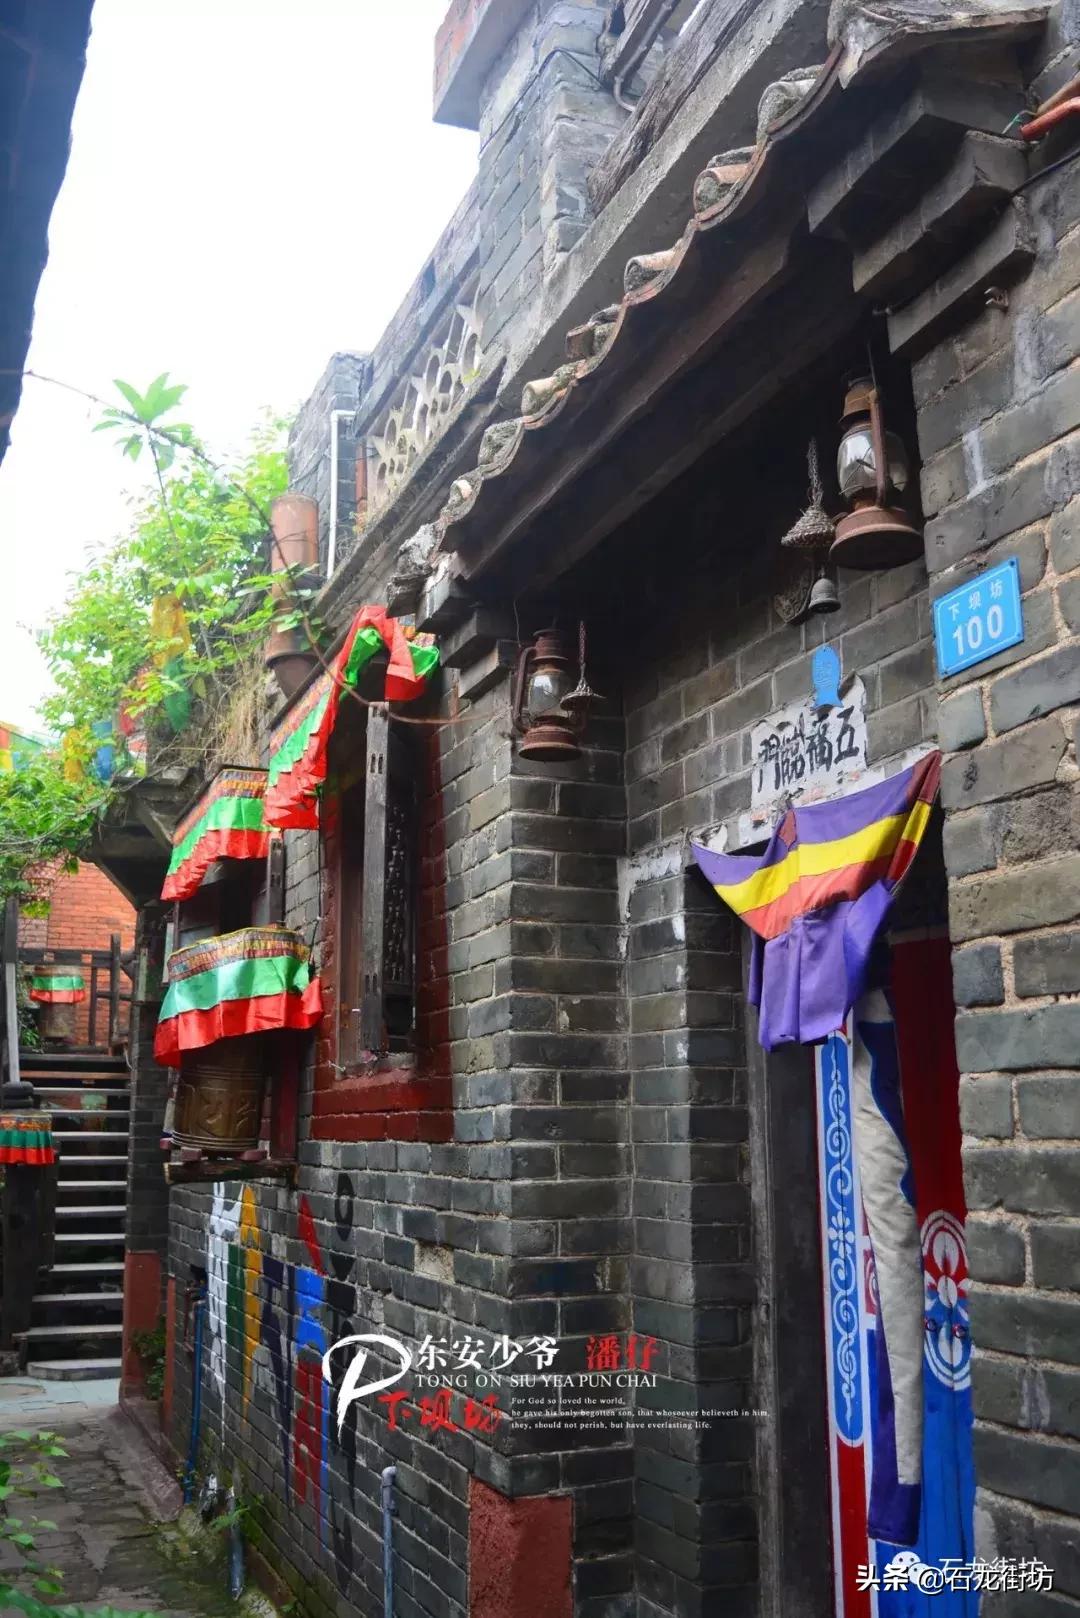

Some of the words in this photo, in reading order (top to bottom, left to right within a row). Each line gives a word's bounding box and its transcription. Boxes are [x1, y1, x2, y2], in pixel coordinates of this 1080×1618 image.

[948, 579, 1004, 621] 下坝坊
[952, 604, 1004, 656] 100
